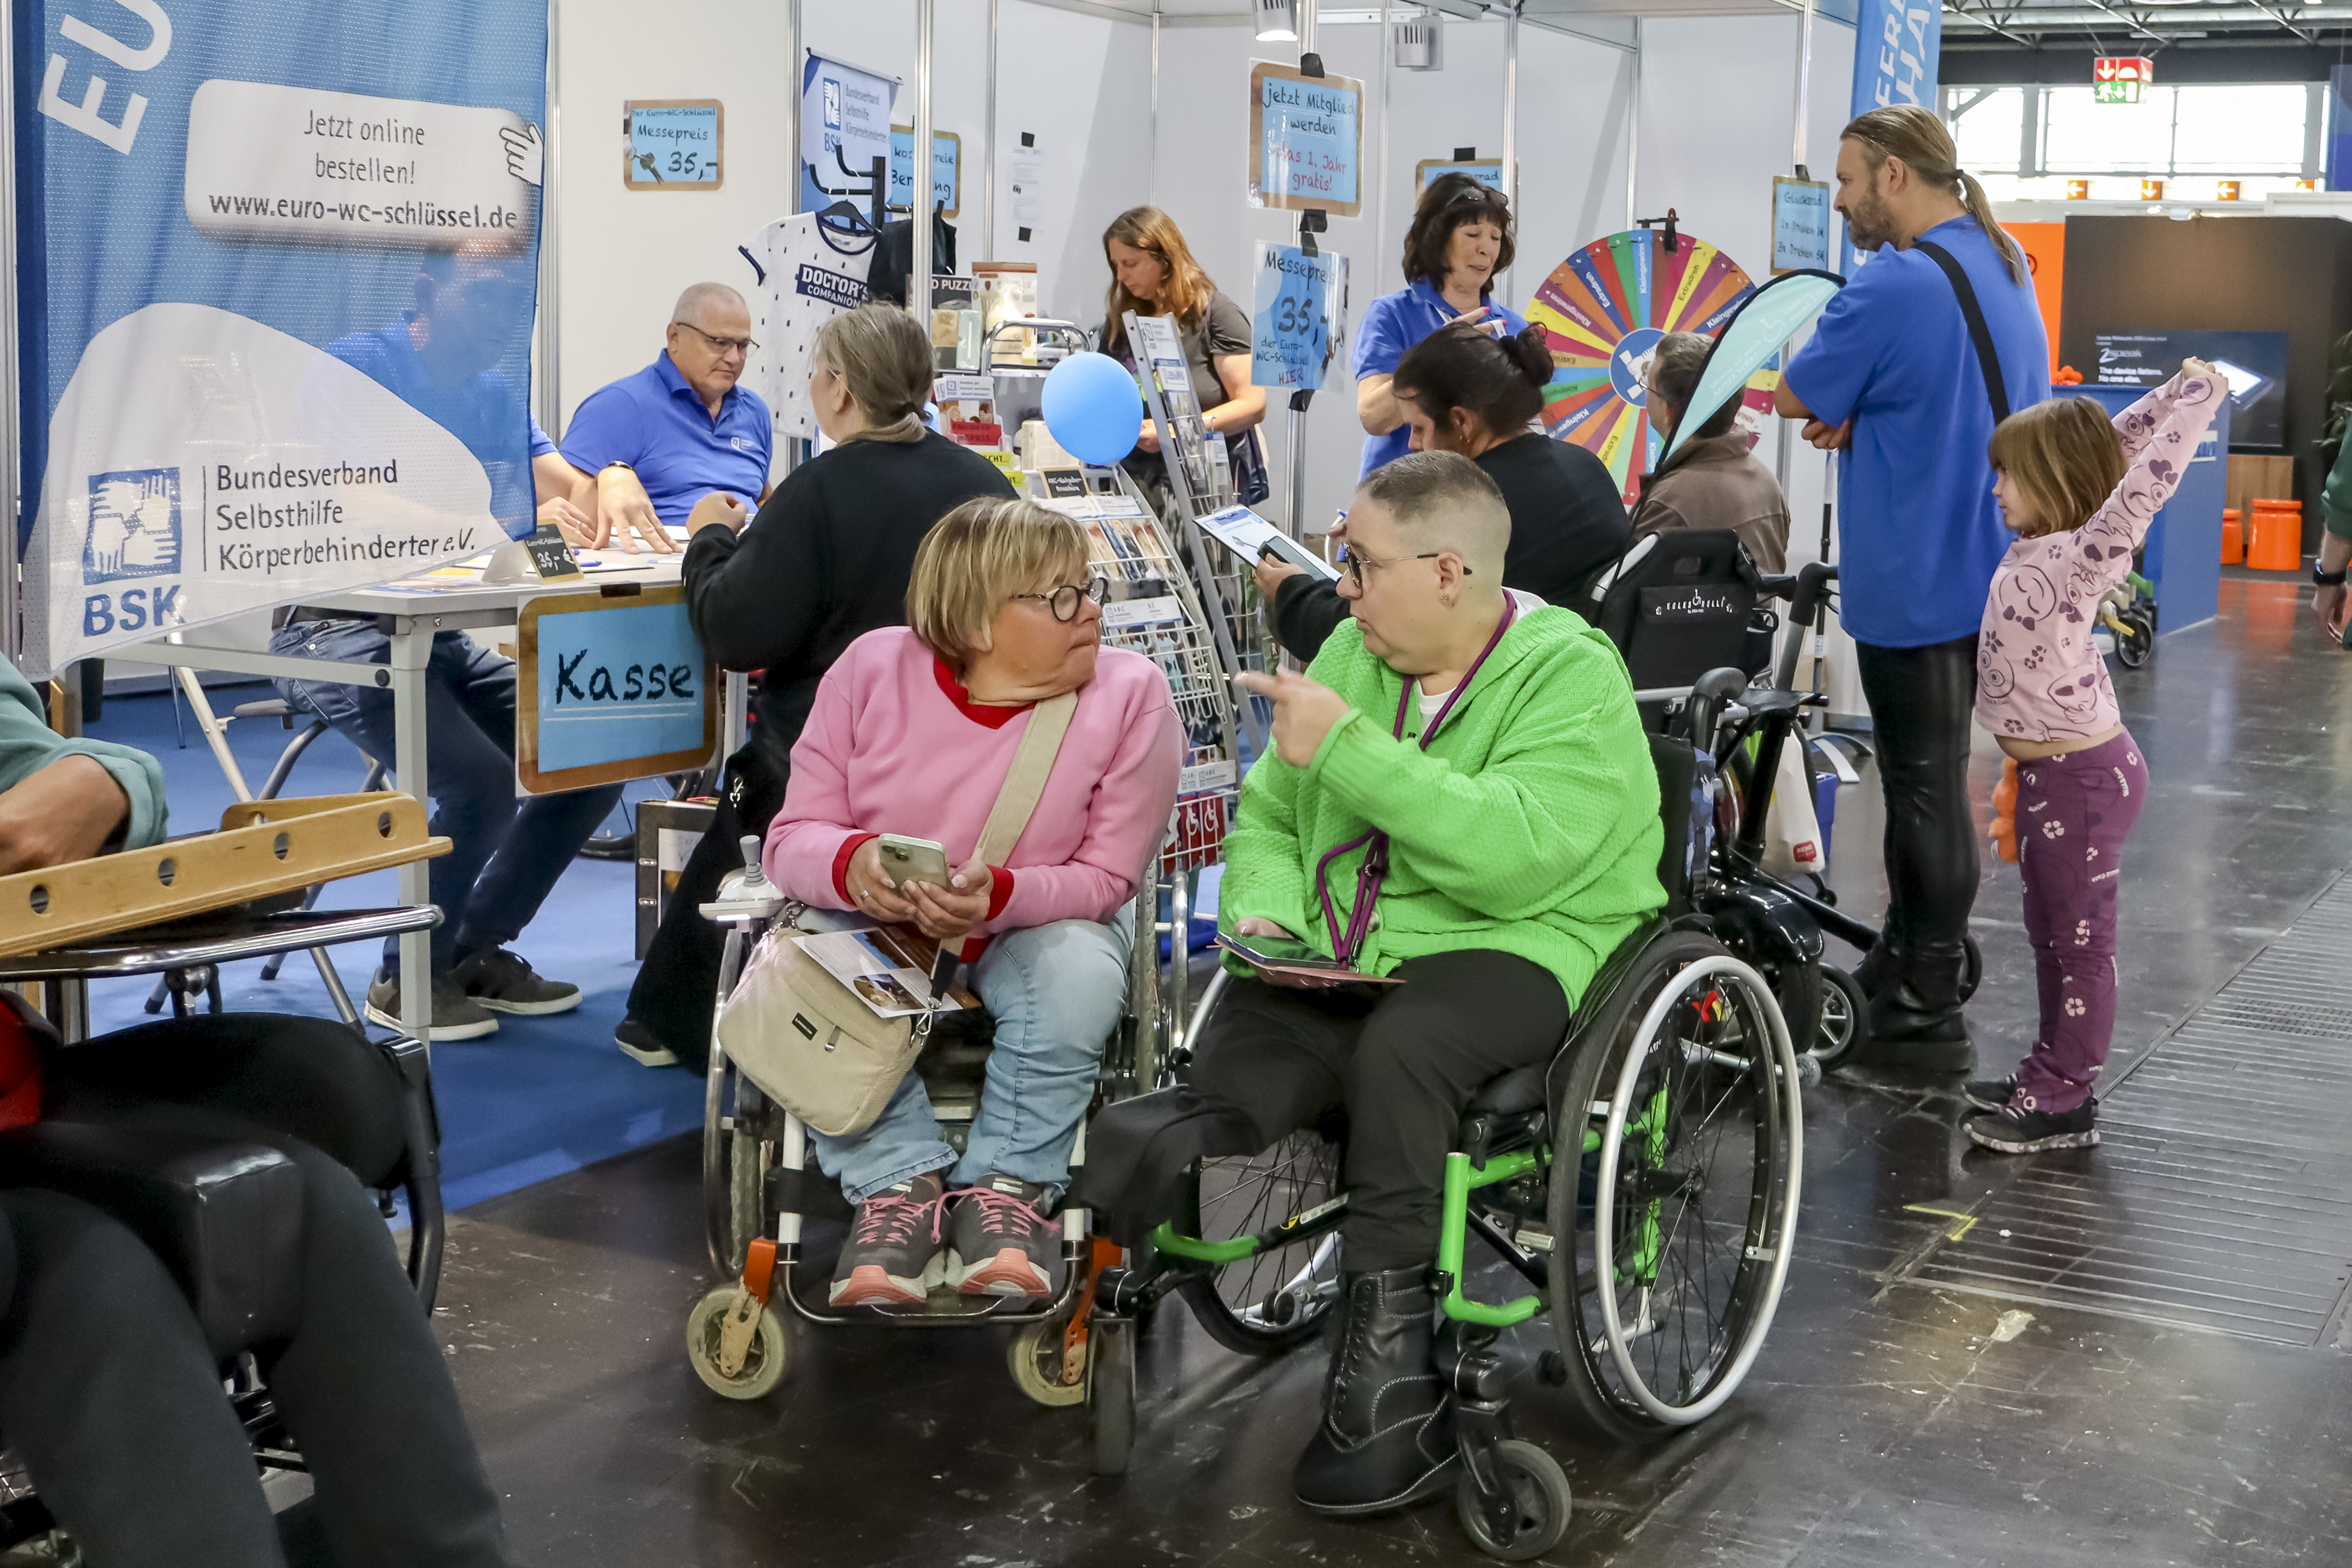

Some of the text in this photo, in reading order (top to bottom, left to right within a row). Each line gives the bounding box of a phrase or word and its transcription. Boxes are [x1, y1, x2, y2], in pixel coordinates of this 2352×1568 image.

[1263, 83, 1300, 108] jetzt
[304, 109, 425, 145] Jetzt online
[637, 124, 708, 147] Messepreis
[1290, 116, 1337, 135] werden
[315, 153, 415, 184] bestellen!
[668, 151, 718, 181] 35,-
[1323, 155, 1346, 174] Jahr
[1293, 172, 1332, 191] gratis!
[209, 194, 517, 229] www.euro-wc-schlüssel.de
[802, 266, 869, 301] DOCTOR'S
[807, 284, 862, 308] COMPANION
[1678, 264, 1700, 302] Extradreh
[1278, 295, 1329, 347] 35,-
[1262, 337, 1275, 348] der
[1278, 368, 1304, 385] HIER
[217, 459, 399, 491] Bundesverband
[217, 500, 344, 531] Selbsthilfe
[219, 528, 475, 575] Körperbehinderter e.V.
[84, 584, 185, 637] BSK
[556, 648, 694, 704] Kasse
